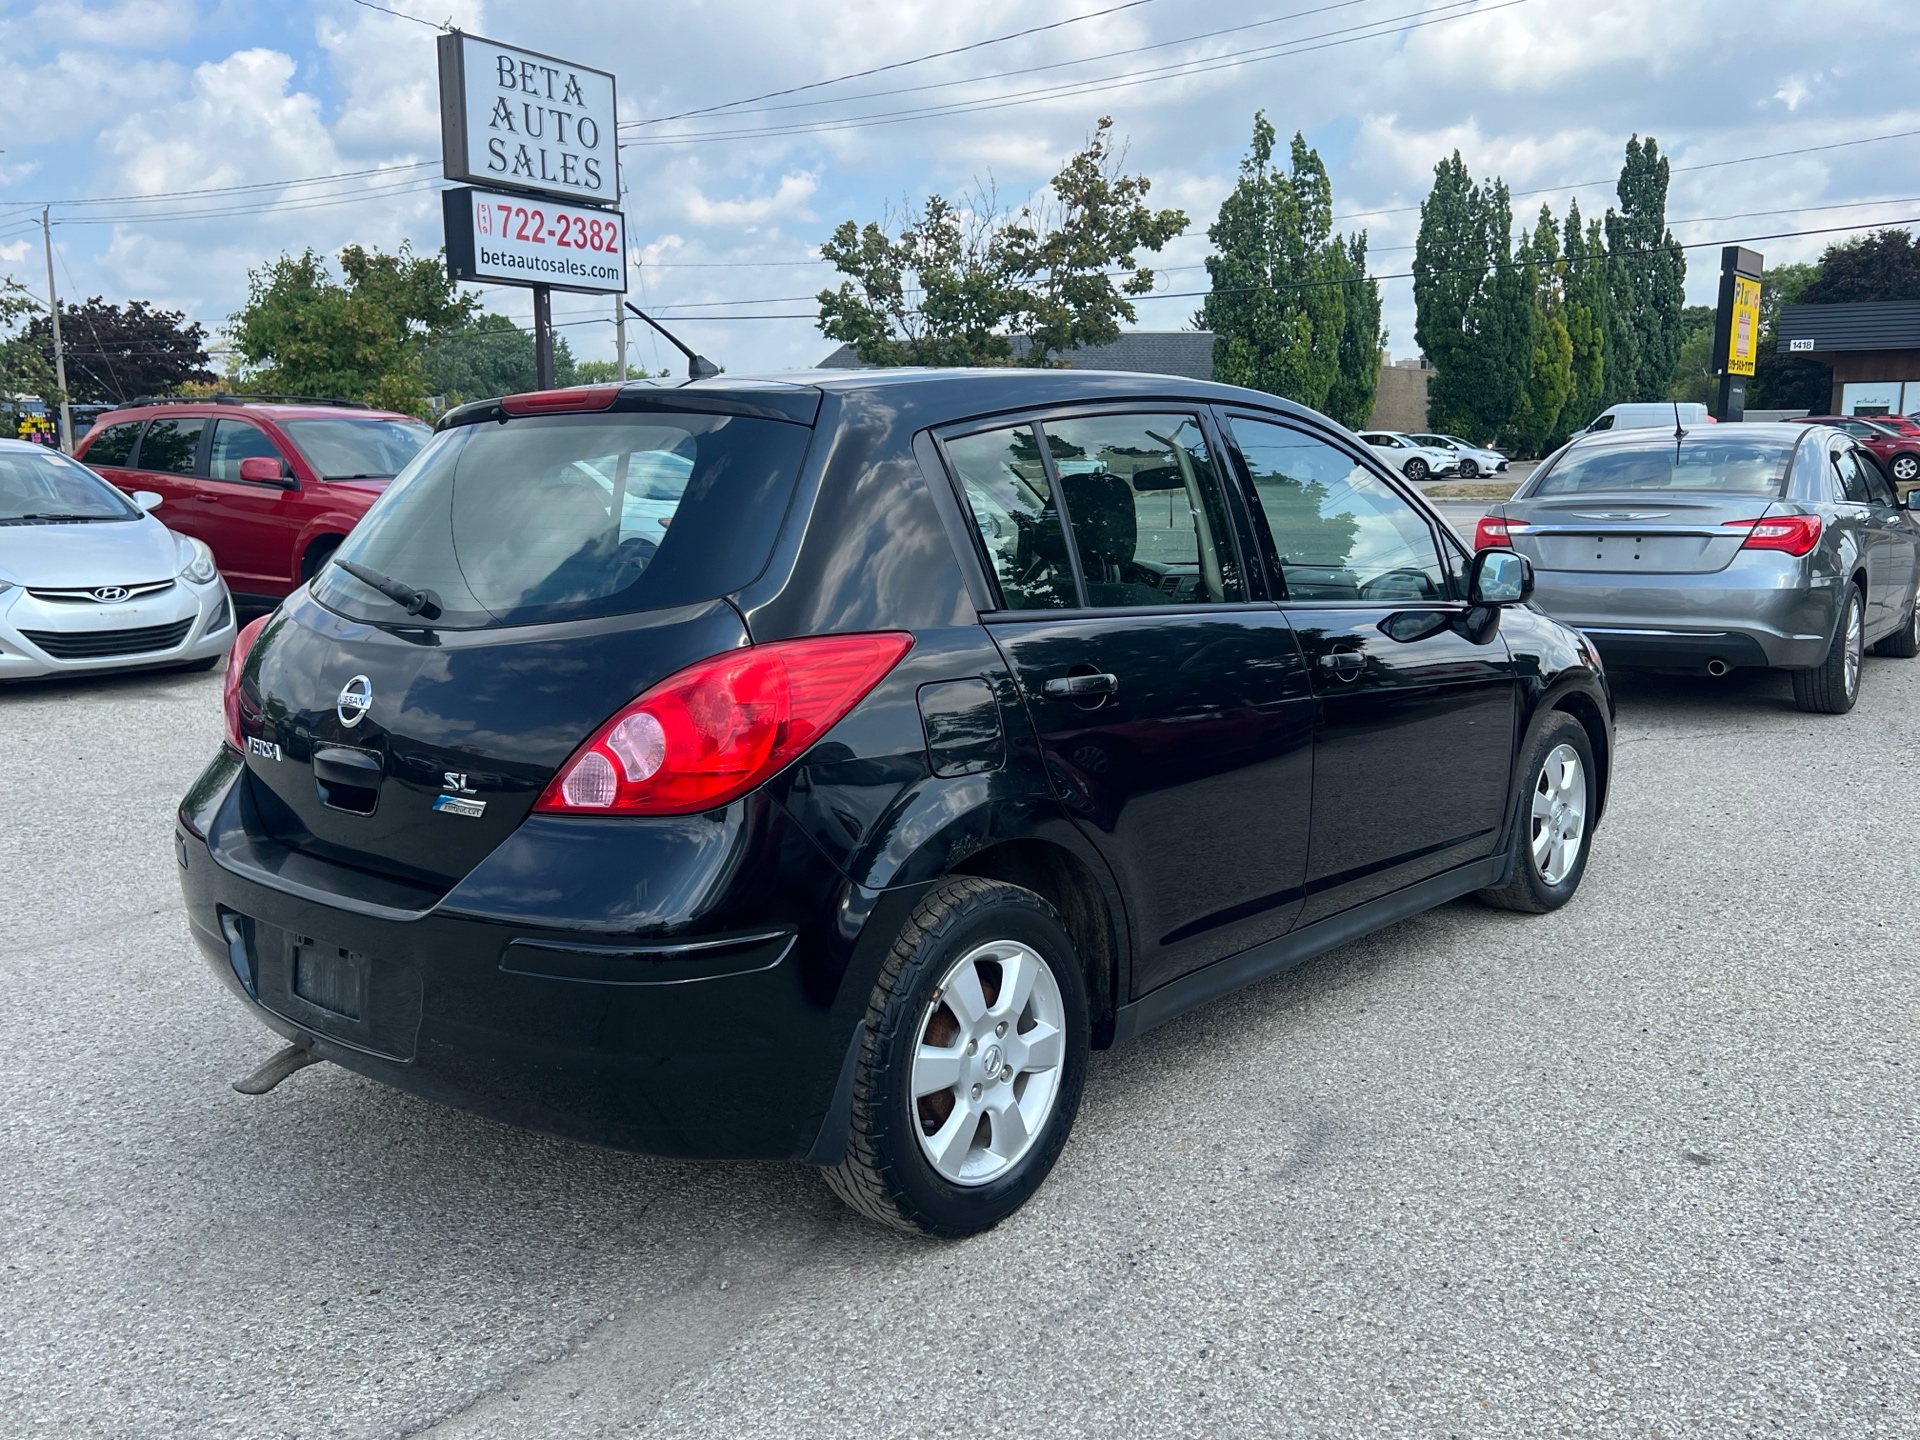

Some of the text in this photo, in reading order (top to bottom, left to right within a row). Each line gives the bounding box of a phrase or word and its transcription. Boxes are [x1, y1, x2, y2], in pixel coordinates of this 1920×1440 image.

[496, 55, 587, 108] BETA
[488, 96, 600, 150] AUTO
[487, 137, 602, 191] SALES
[497, 204, 619, 254] 722-2382
[481, 246, 620, 280] betaautosales.com
[1793, 341, 1812, 350] 1418
[340, 694, 367, 706] SSAN
[247, 735, 284, 762] VERSA
[442, 771, 478, 795] SL
